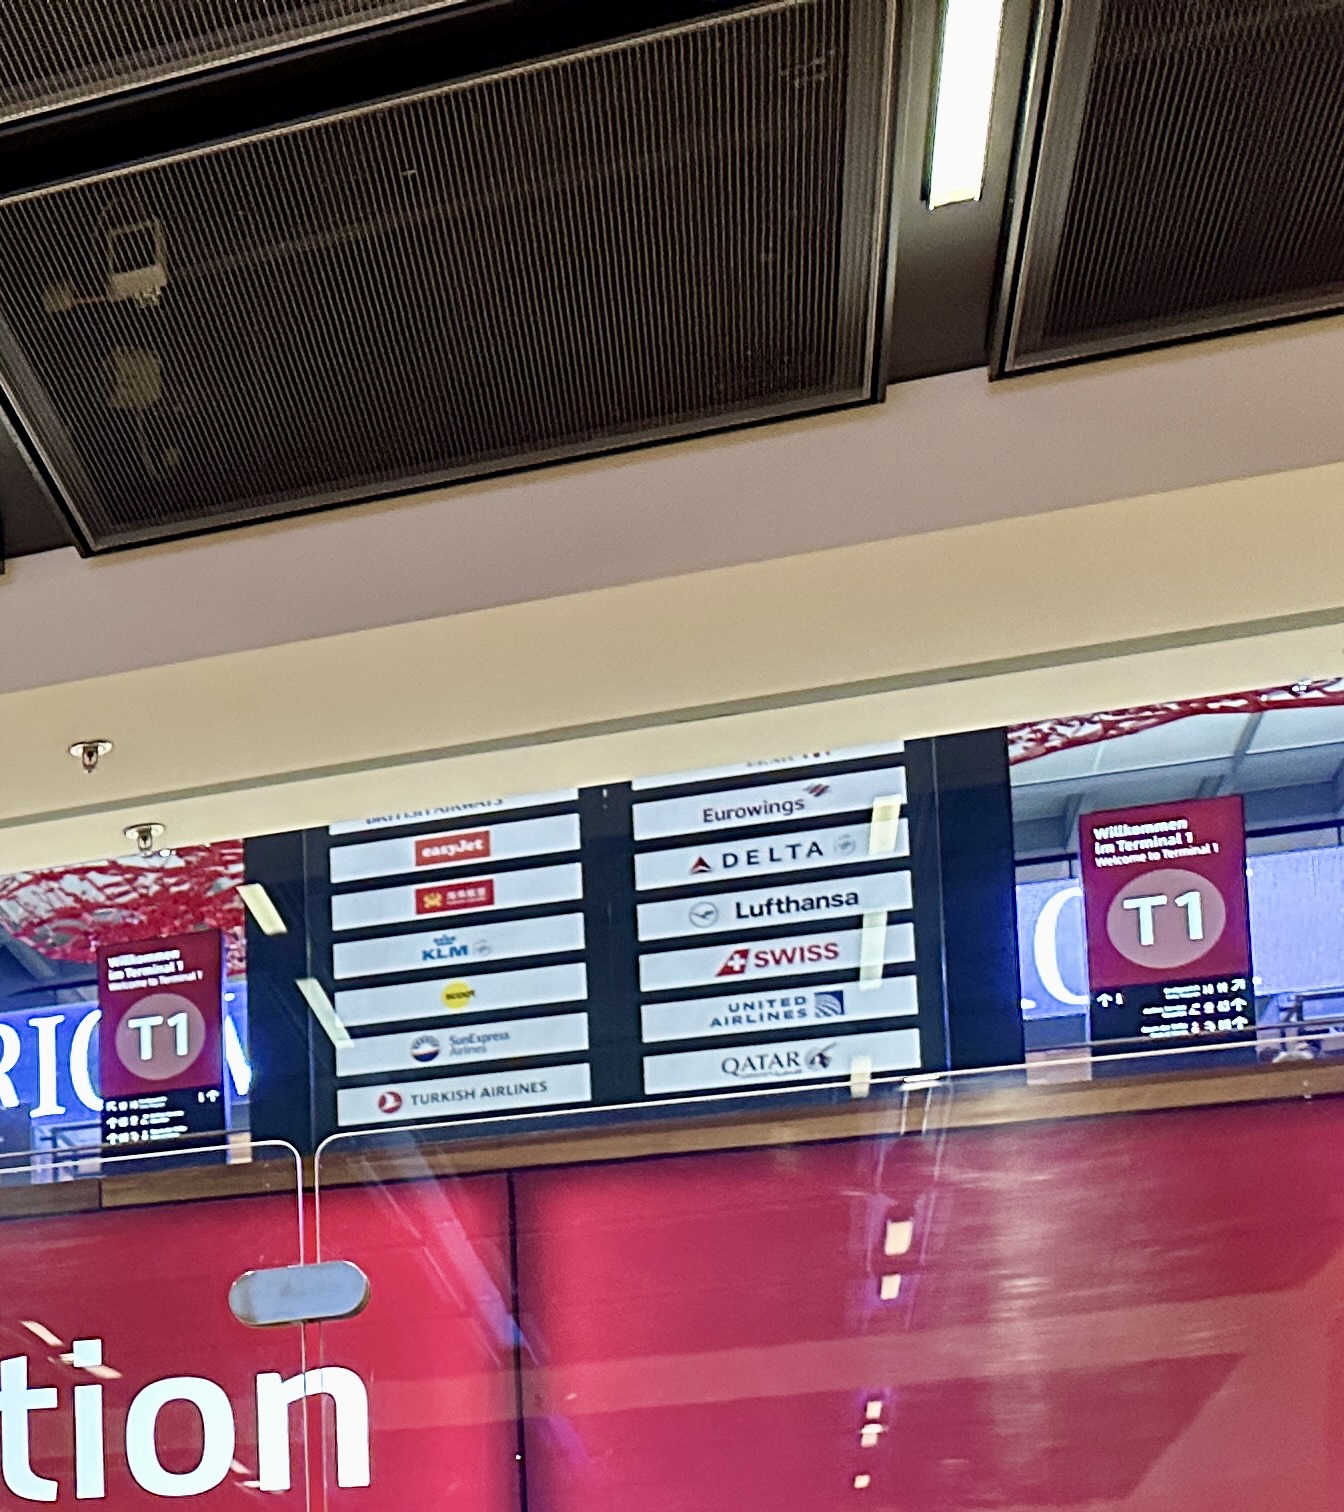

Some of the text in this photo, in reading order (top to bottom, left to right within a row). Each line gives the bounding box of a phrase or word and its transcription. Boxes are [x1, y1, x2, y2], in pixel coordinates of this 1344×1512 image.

[703, 798, 805, 823] Eurowings
[1093, 819, 1188, 840] Willkommen
[1115, 832, 1183, 852] Terminal
[1185, 831, 1193, 844] 1
[421, 838, 484, 857] easyJet
[723, 841, 824, 868] DELTA
[735, 889, 859, 919] Lufthansa
[1123, 891, 1204, 945] T1
[422, 945, 468, 961] KLM
[754, 942, 840, 969] SWISS
[728, 996, 806, 1013] UNITED
[710, 1008, 808, 1028] AIRLINES
[127, 1012, 188, 1060] T1
[721, 1050, 800, 1076] QATAR
[411, 1081, 548, 1106] TURKISH AIRLINES
